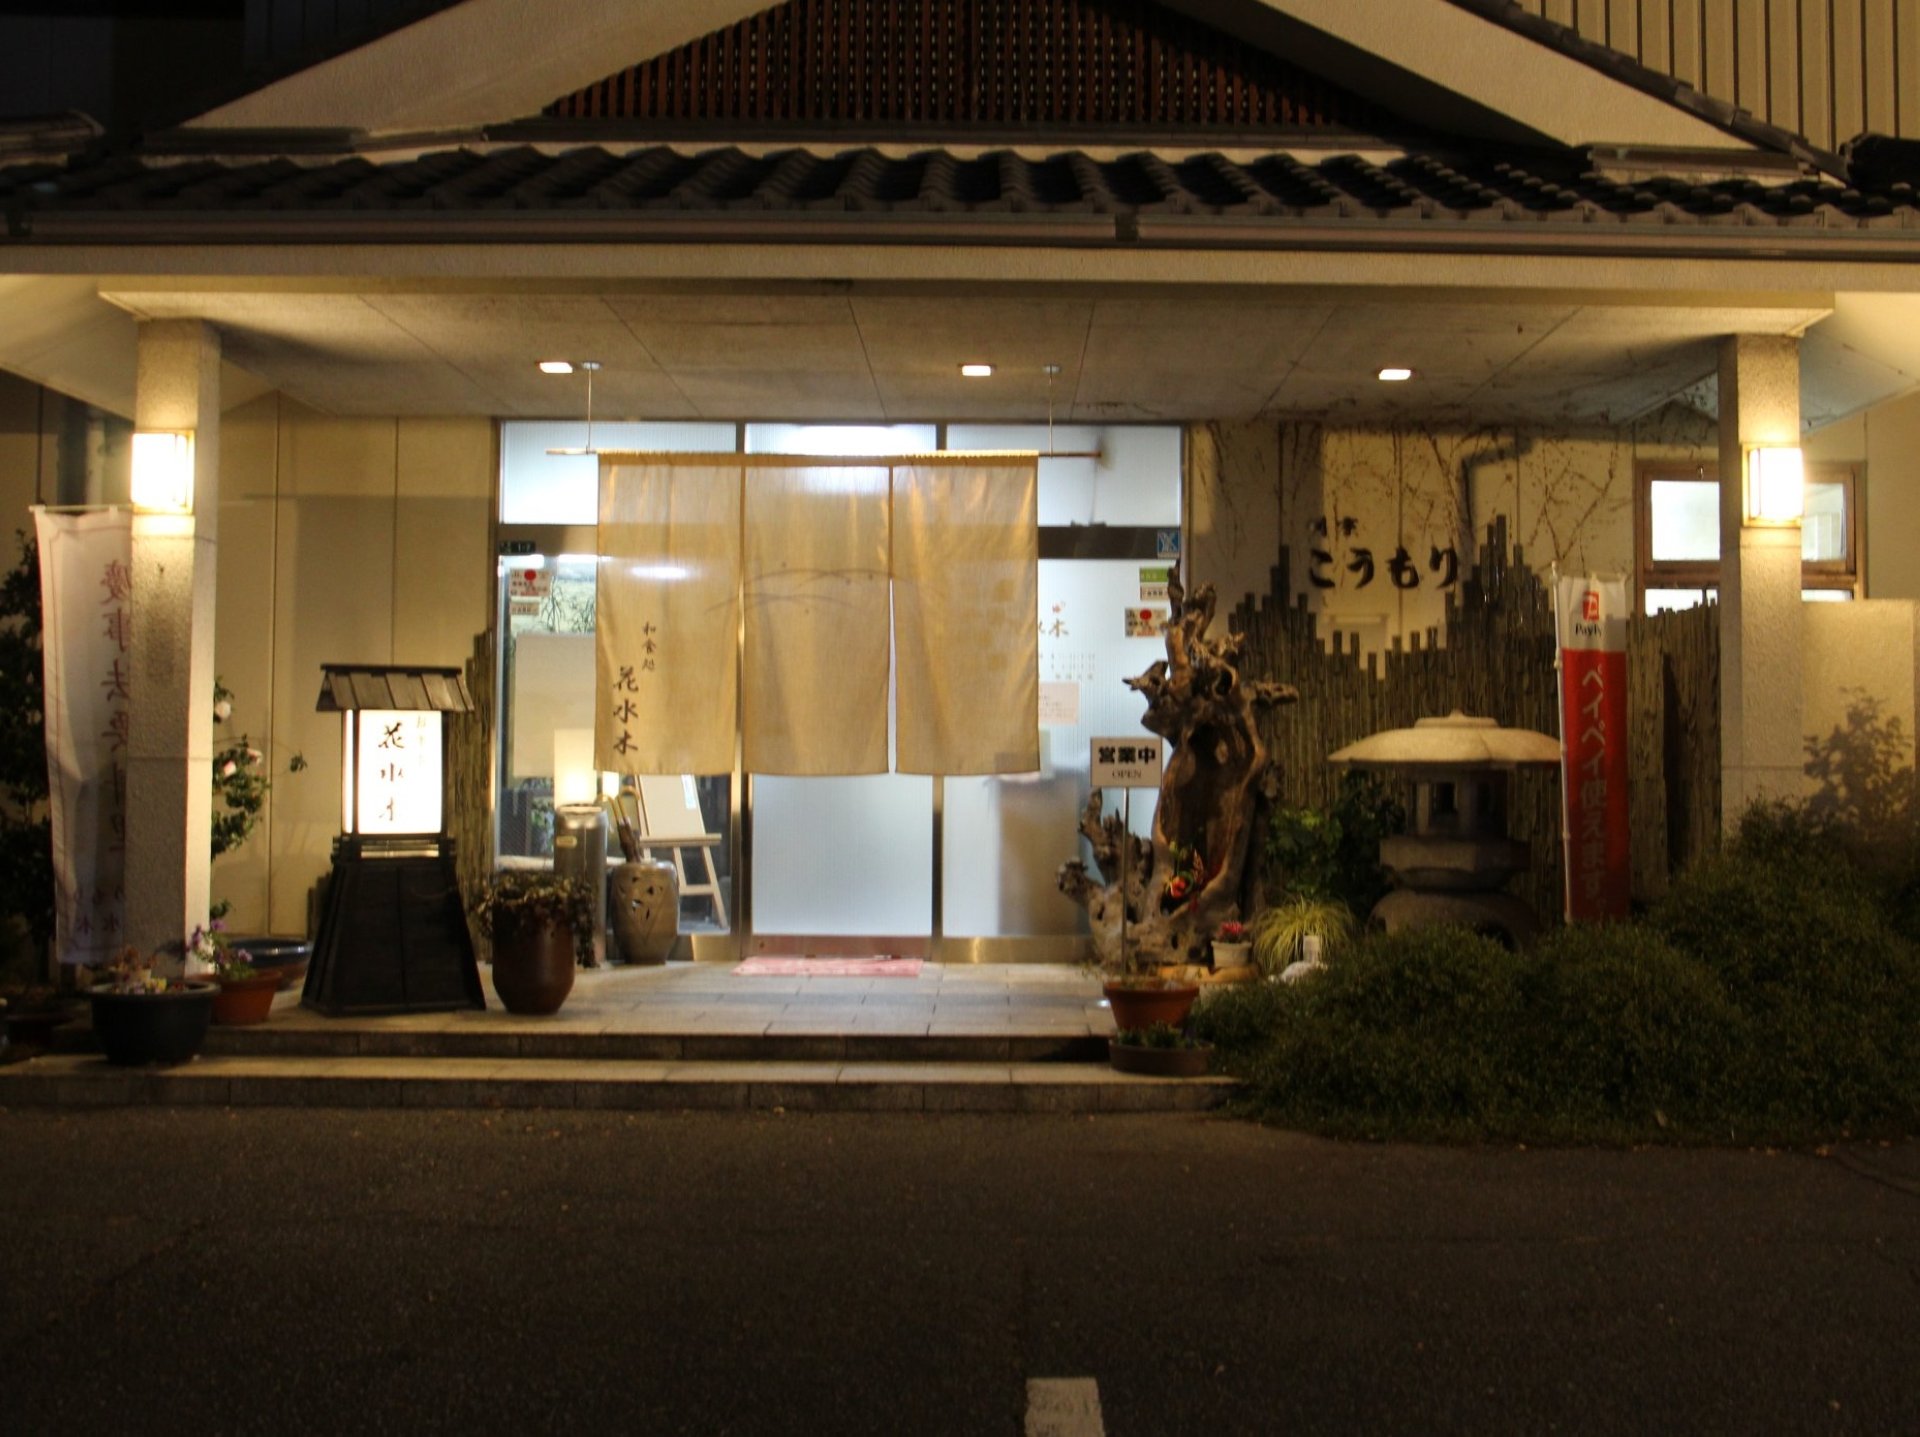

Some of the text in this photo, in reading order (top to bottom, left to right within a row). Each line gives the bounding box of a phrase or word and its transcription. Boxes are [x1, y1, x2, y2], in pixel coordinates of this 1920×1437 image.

[1308, 545, 1459, 589] こうもり
[642, 621, 656, 672] 和食処
[613, 665, 639, 757] 花水木
[1098, 746, 1157, 764] 営業中
[1112, 770, 1142, 780] OPEN
